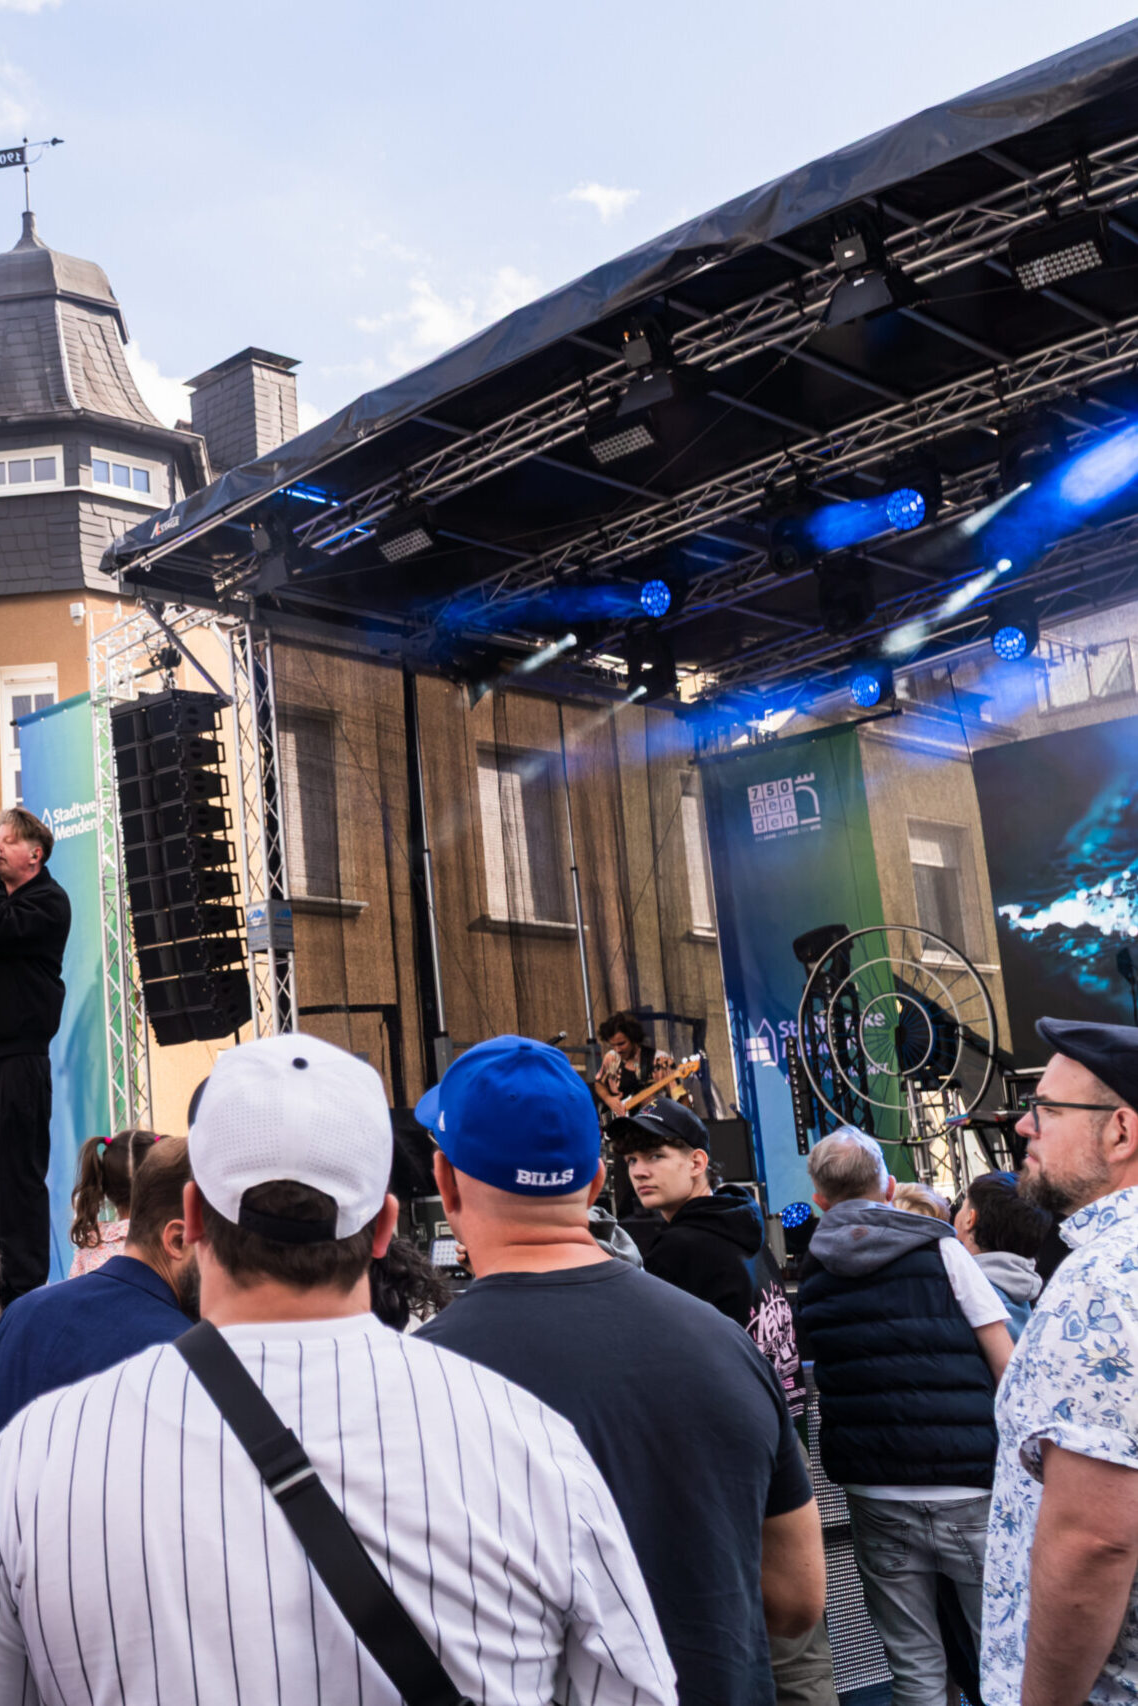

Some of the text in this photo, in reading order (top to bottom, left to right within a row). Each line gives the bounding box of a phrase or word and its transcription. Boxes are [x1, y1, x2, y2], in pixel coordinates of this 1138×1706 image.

[750, 781, 789, 799] 750
[752, 798, 792, 816] men
[54, 817, 99, 841] Menden
[755, 814, 795, 832] den
[516, 1168, 574, 1187] BILLS
